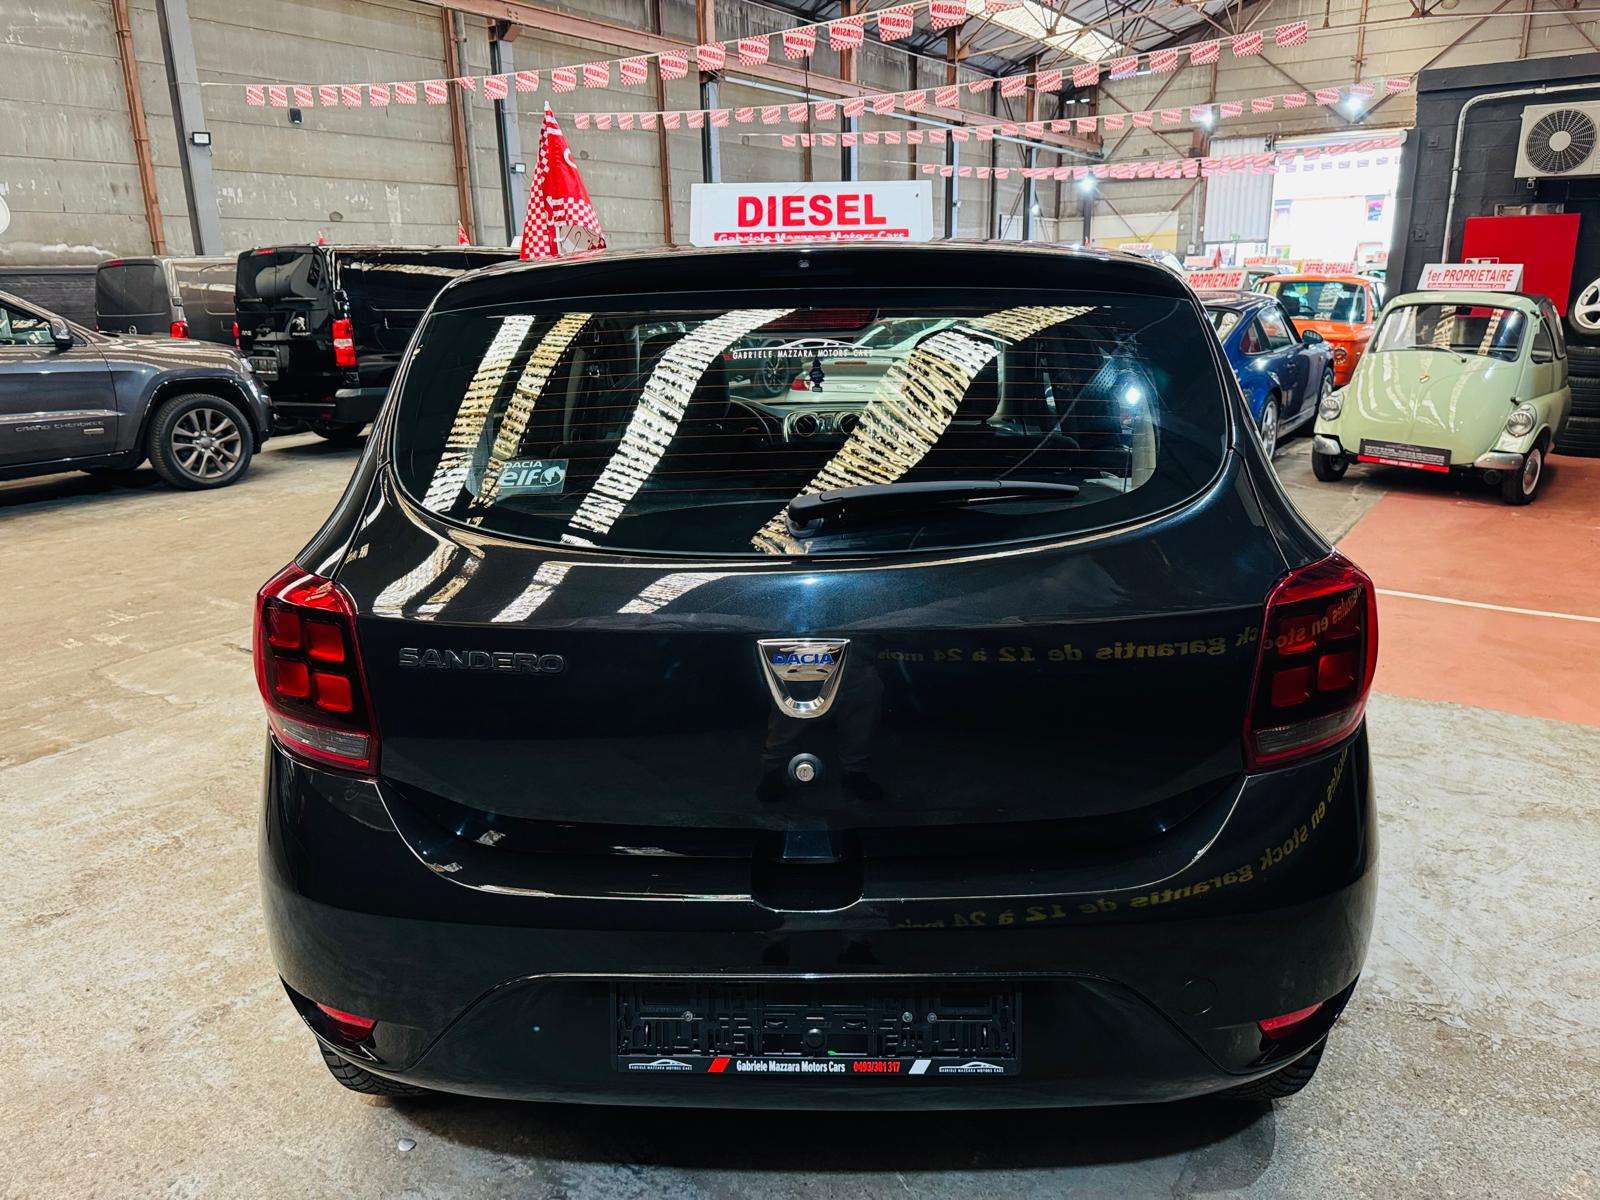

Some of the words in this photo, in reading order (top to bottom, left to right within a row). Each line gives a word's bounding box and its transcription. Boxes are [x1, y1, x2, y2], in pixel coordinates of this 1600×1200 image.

[1233, 34, 1262, 53] OCCASION
[1277, 26, 1307, 44] OCCASION
[1192, 44, 1219, 60] OCCASION
[738, 193, 887, 228] DIESEL
[1188, 272, 1242, 289] PROPRIETAIRE
[1443, 269, 1514, 282] PROPRIETAIRE
[732, 350, 772, 359] GABRIELE
[777, 350, 813, 358] MAZZARA
[818, 349, 848, 357] MOTORS
[500, 468, 541, 486] elf
[398, 647, 565, 674] SANDERO
[770, 652, 835, 666] DACIA
[736, 1060, 768, 1072] Gabriele
[768, 1060, 800, 1073] Mazzara
[801, 1060, 828, 1073] Motors
[828, 1061, 846, 1073] Cars
